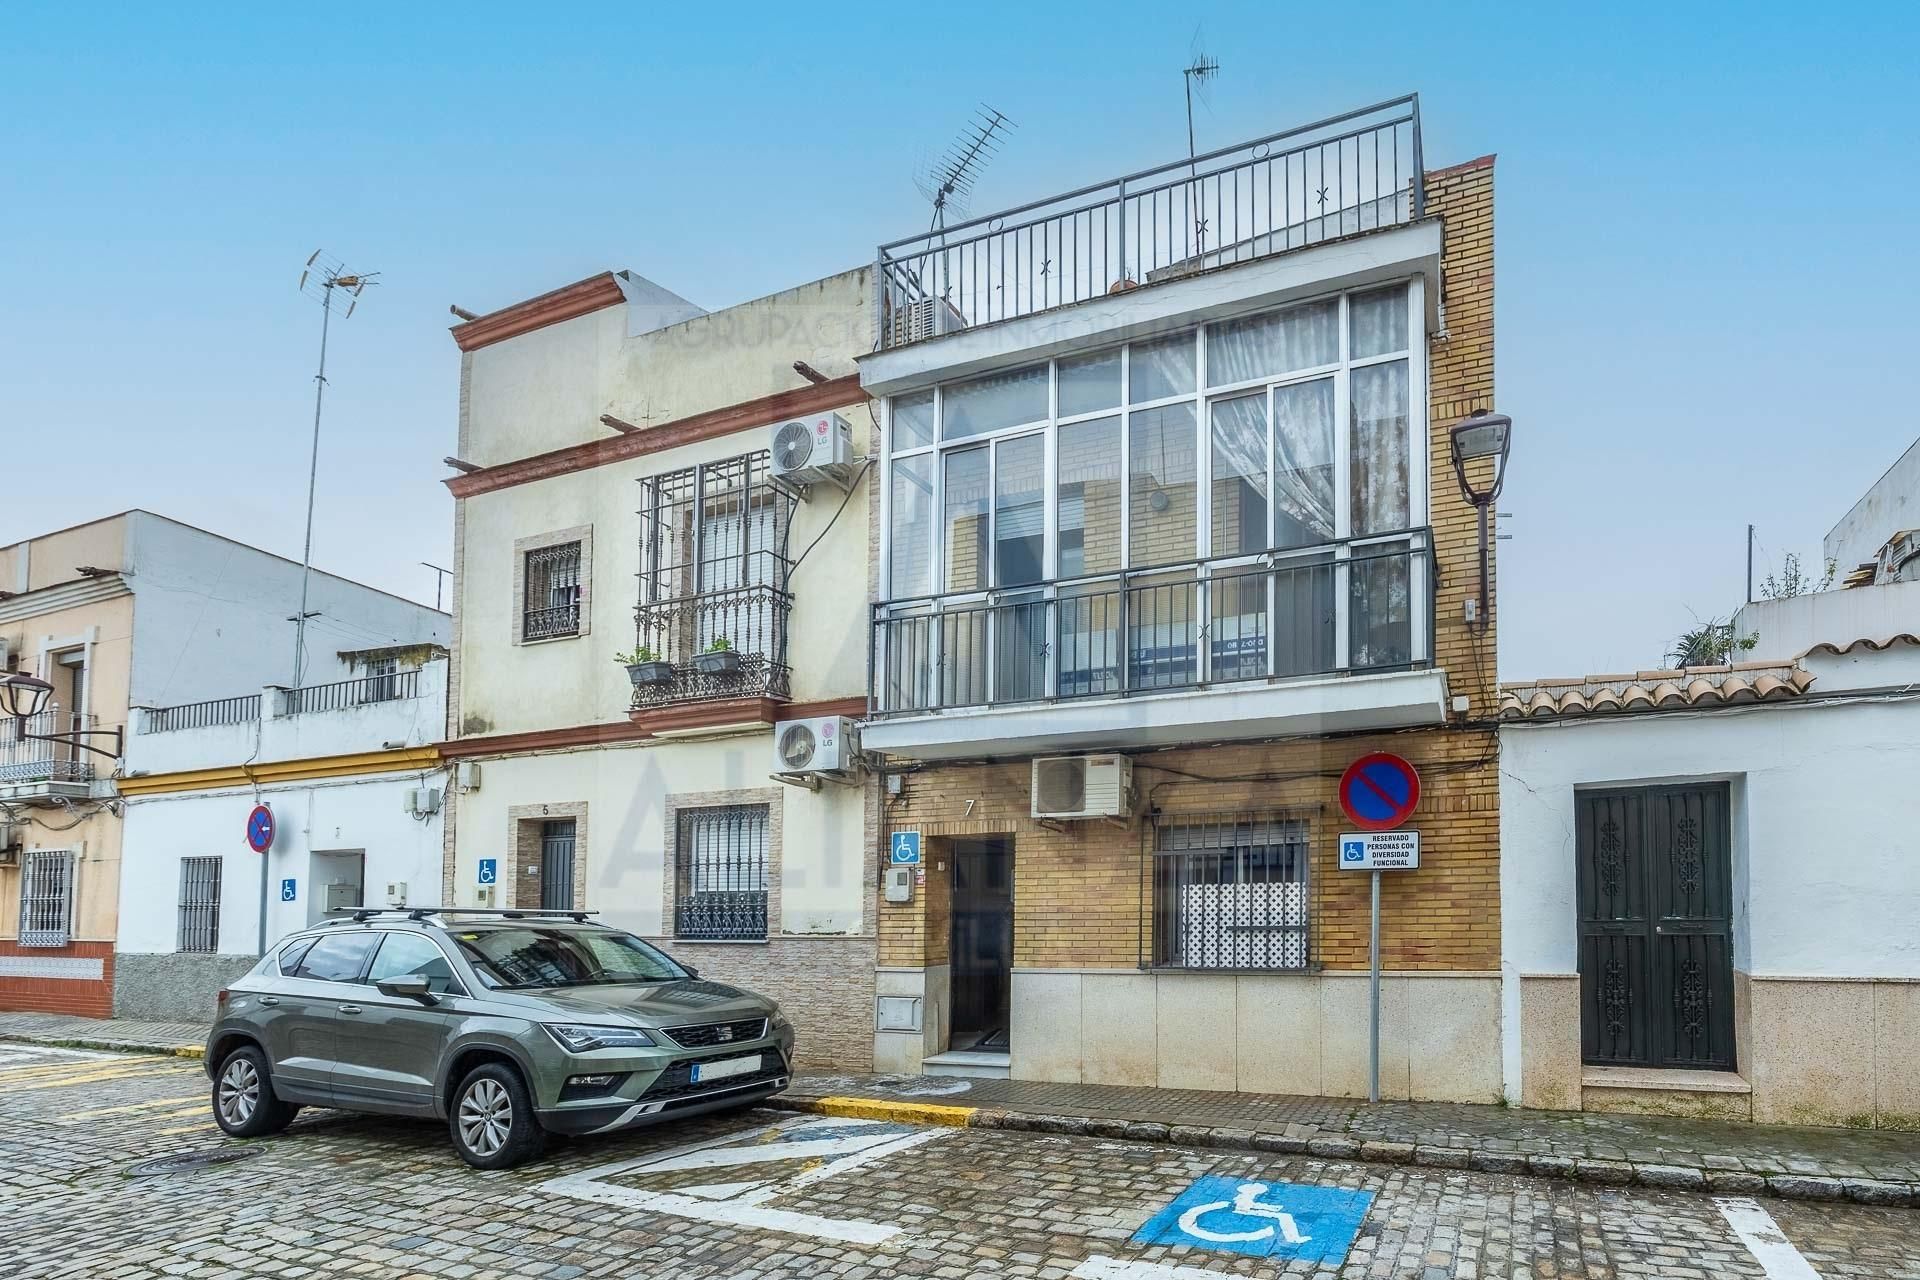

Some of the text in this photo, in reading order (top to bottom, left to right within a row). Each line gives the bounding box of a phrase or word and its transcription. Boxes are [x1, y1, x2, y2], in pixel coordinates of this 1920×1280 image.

[817, 436, 828, 445] LG
[822, 739, 833, 747] LG
[542, 804, 549, 816] 5
[965, 799, 975, 816] 7
[1372, 834, 1409, 842] RESERVADO
